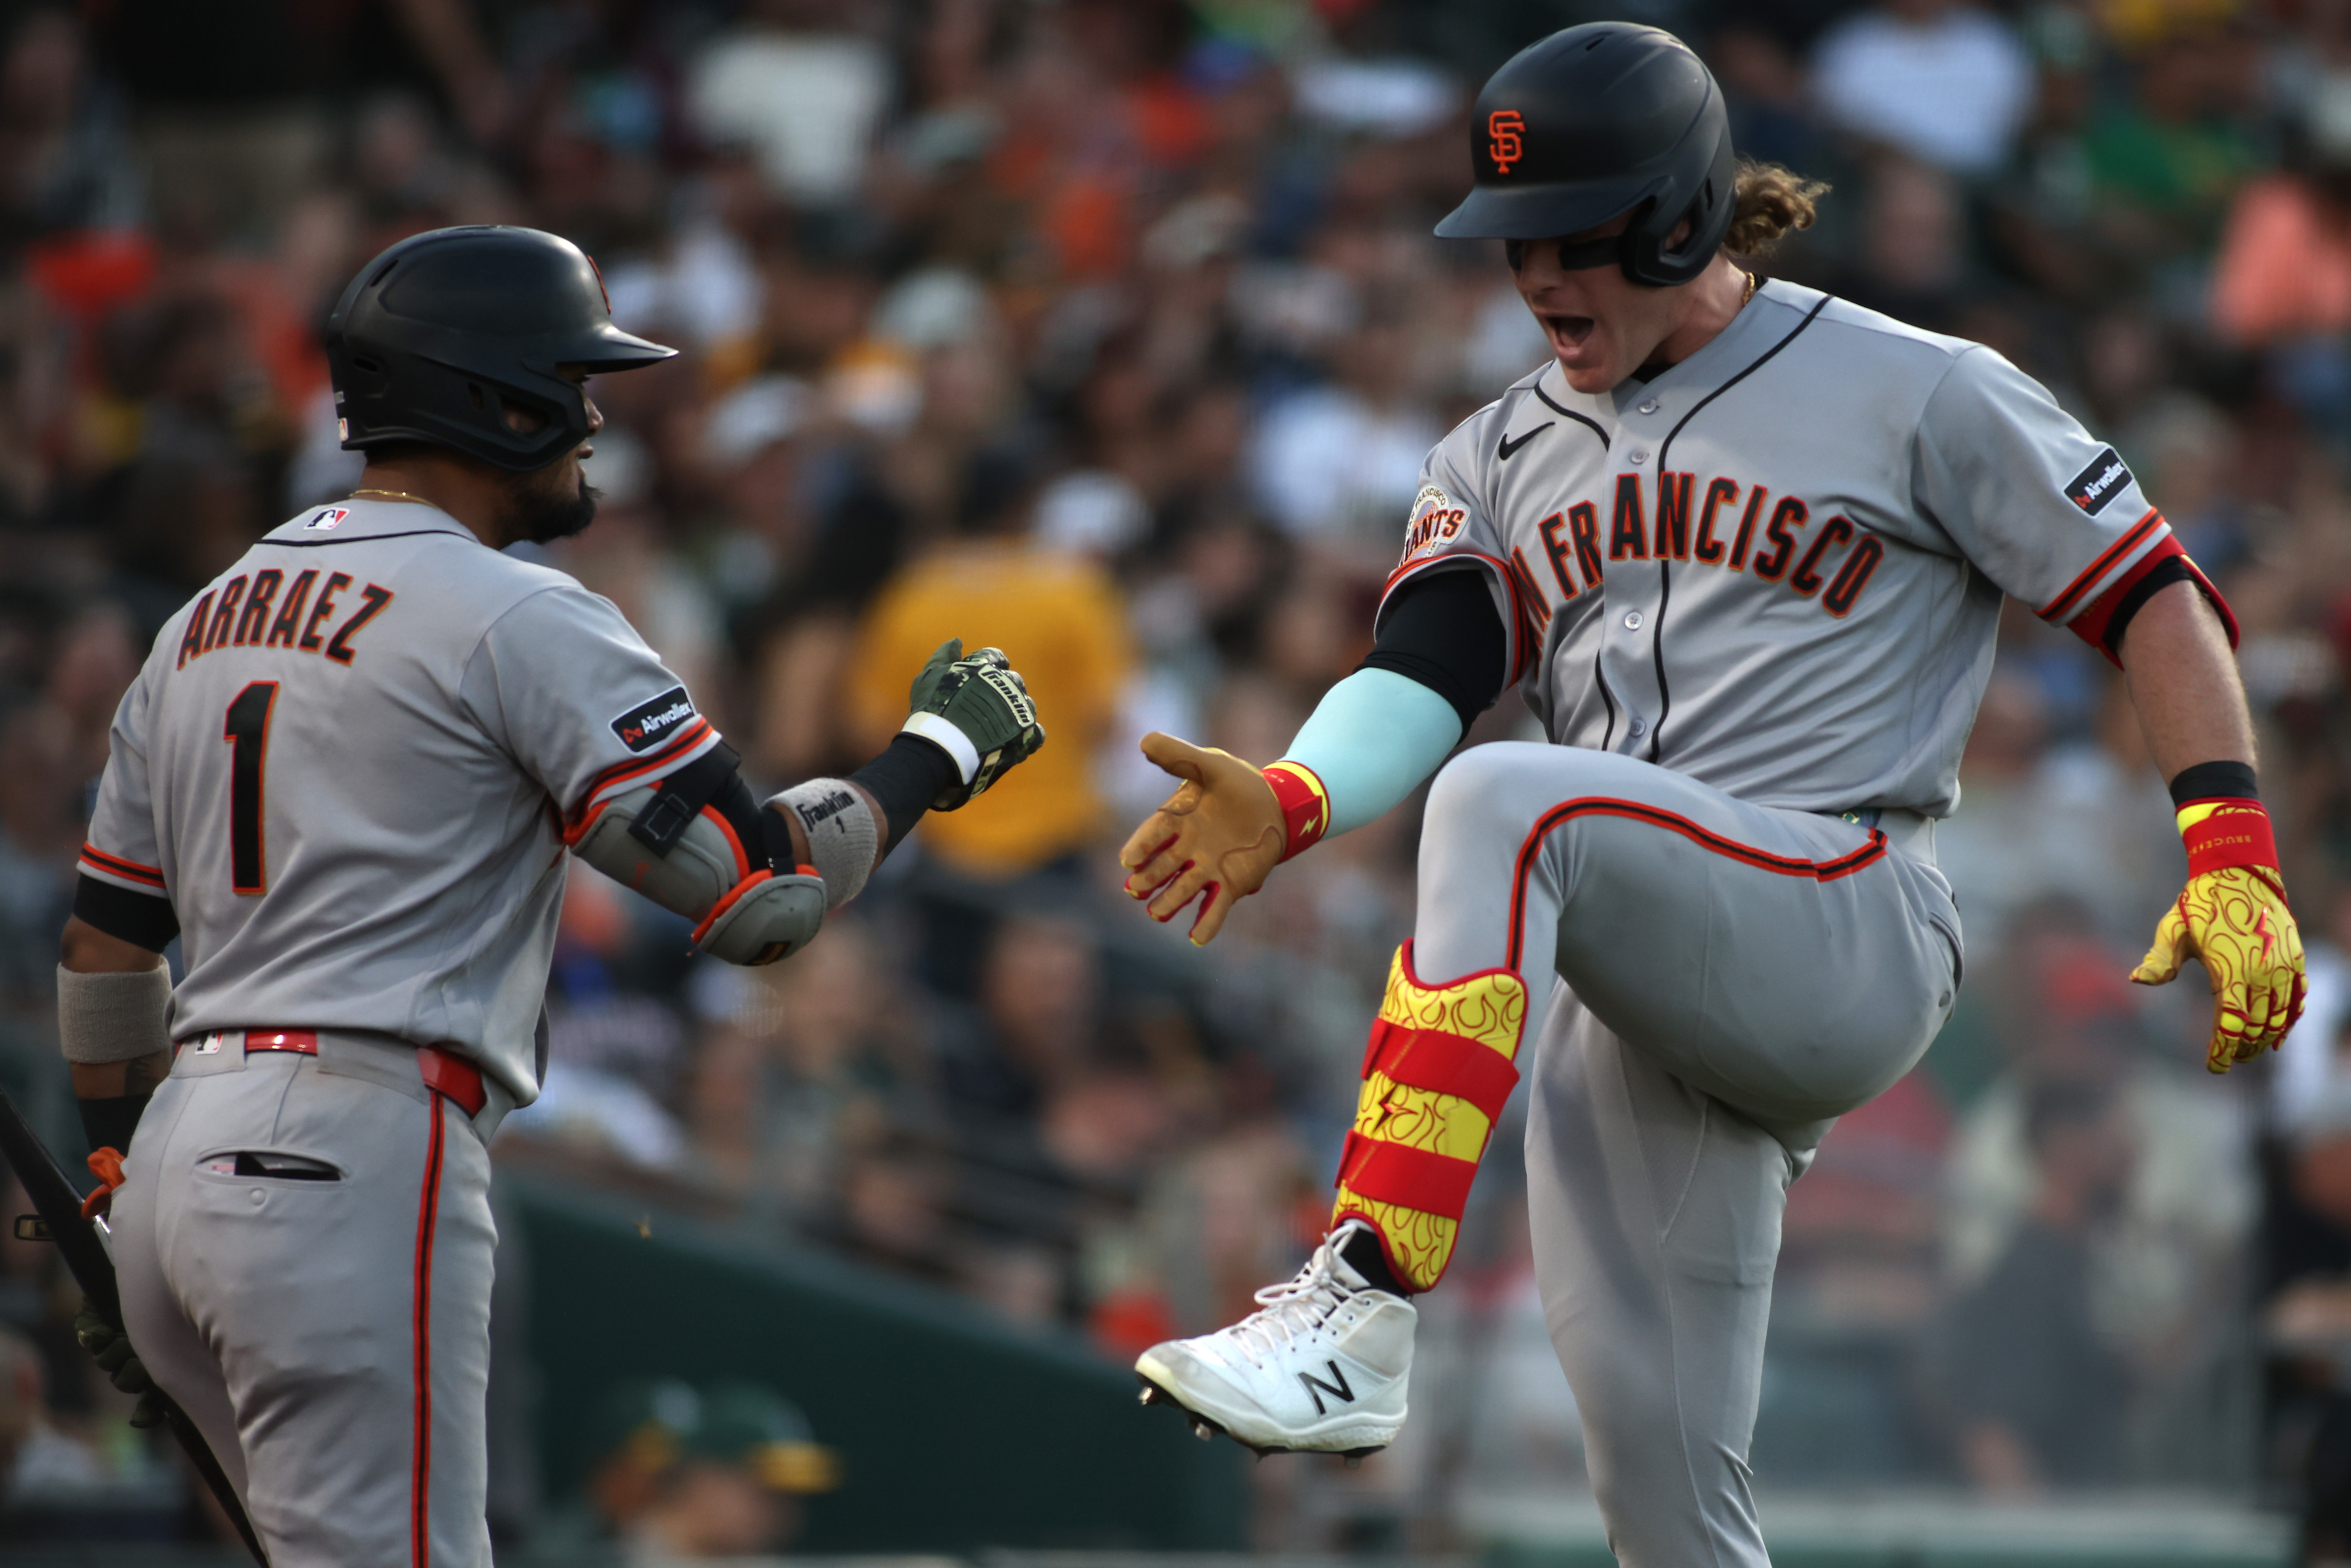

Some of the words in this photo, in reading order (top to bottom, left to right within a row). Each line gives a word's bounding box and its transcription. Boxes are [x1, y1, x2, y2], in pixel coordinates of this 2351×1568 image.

[2084, 461, 2125, 500] Airwallex
[1399, 509, 1466, 567] IANTS
[1538, 471, 1884, 619] FRANCISCO
[177, 568, 394, 670] ARRAEZ
[641, 702, 692, 734] Airwallex
[981, 670, 1030, 723] Franklin
[223, 680, 279, 895] 1
[796, 791, 854, 833] Franklin
[1297, 1360, 1355, 1415] N
